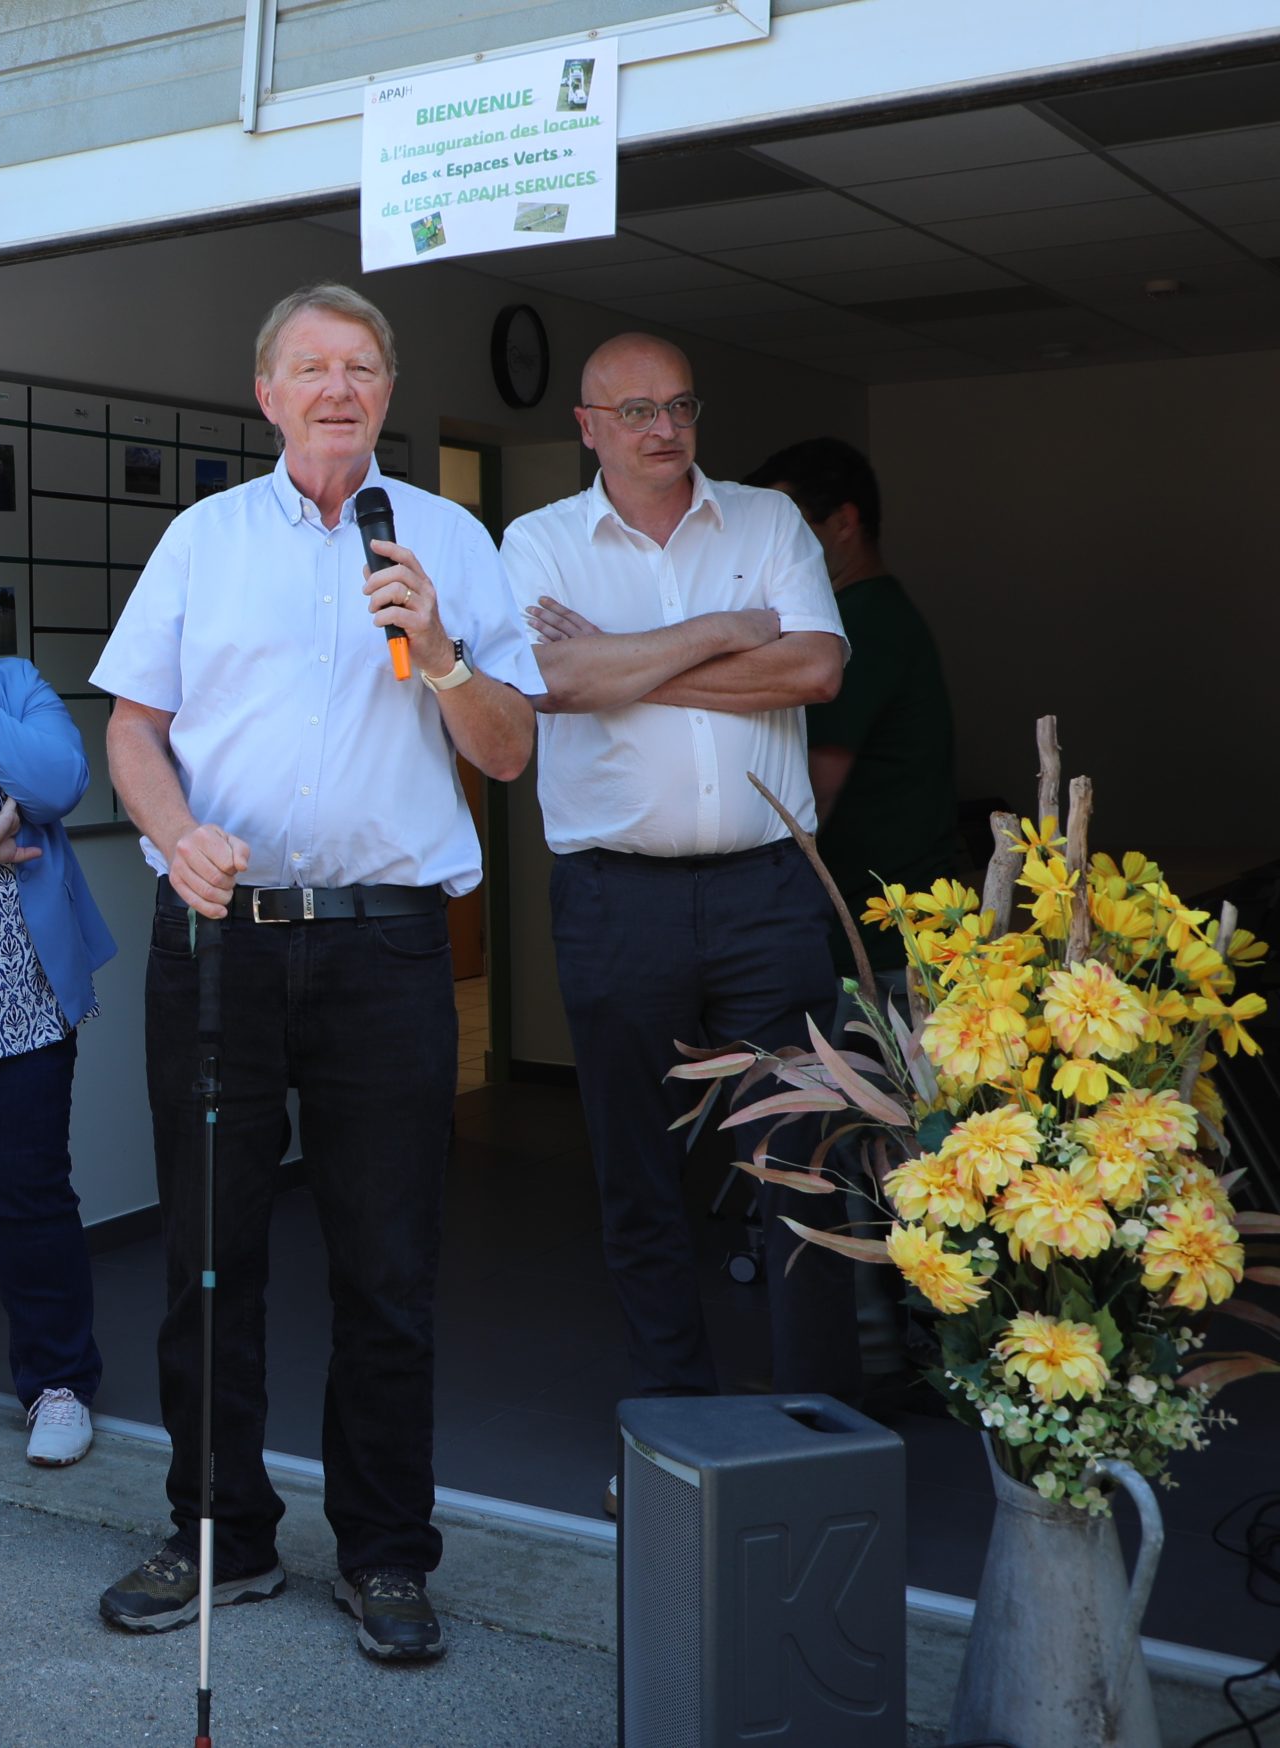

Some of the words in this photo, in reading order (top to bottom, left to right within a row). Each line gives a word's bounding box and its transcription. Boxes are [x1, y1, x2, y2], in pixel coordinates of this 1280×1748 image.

[379, 84, 413, 101] APAJH
[416, 89, 534, 125] BIENVENUE
[381, 148, 389, 163] à
[394, 130, 504, 160] l'inauguration
[510, 124, 538, 139] des
[544, 115, 600, 134] locaux
[401, 170, 427, 185] des
[432, 169, 441, 178] «
[446, 157, 509, 178] Espaces
[513, 148, 558, 166] Verts
[563, 148, 573, 157] »
[381, 202, 400, 217] de
[404, 192, 452, 213] L'ESAT
[457, 183, 509, 205] APAJH
[514, 170, 597, 195] SERVICES
